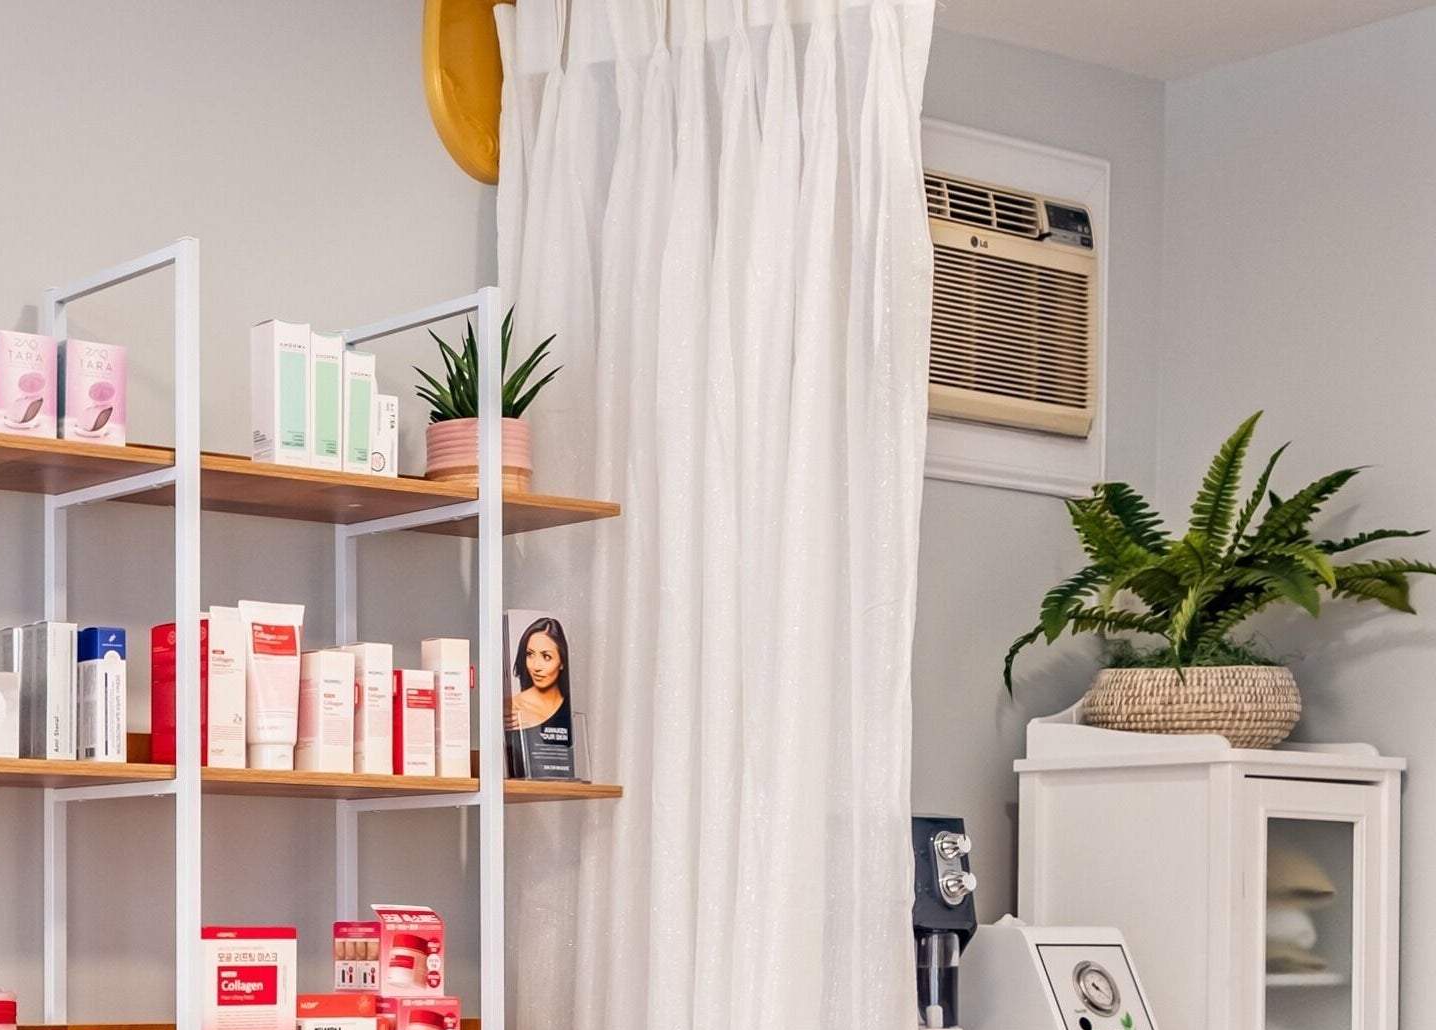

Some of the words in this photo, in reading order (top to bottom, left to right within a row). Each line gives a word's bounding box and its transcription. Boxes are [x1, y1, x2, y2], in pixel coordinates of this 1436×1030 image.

[980, 240, 988, 248] LG
[8, 350, 43, 363] TARA
[80, 360, 113, 372] TARA
[221, 980, 263, 993] Collagen
